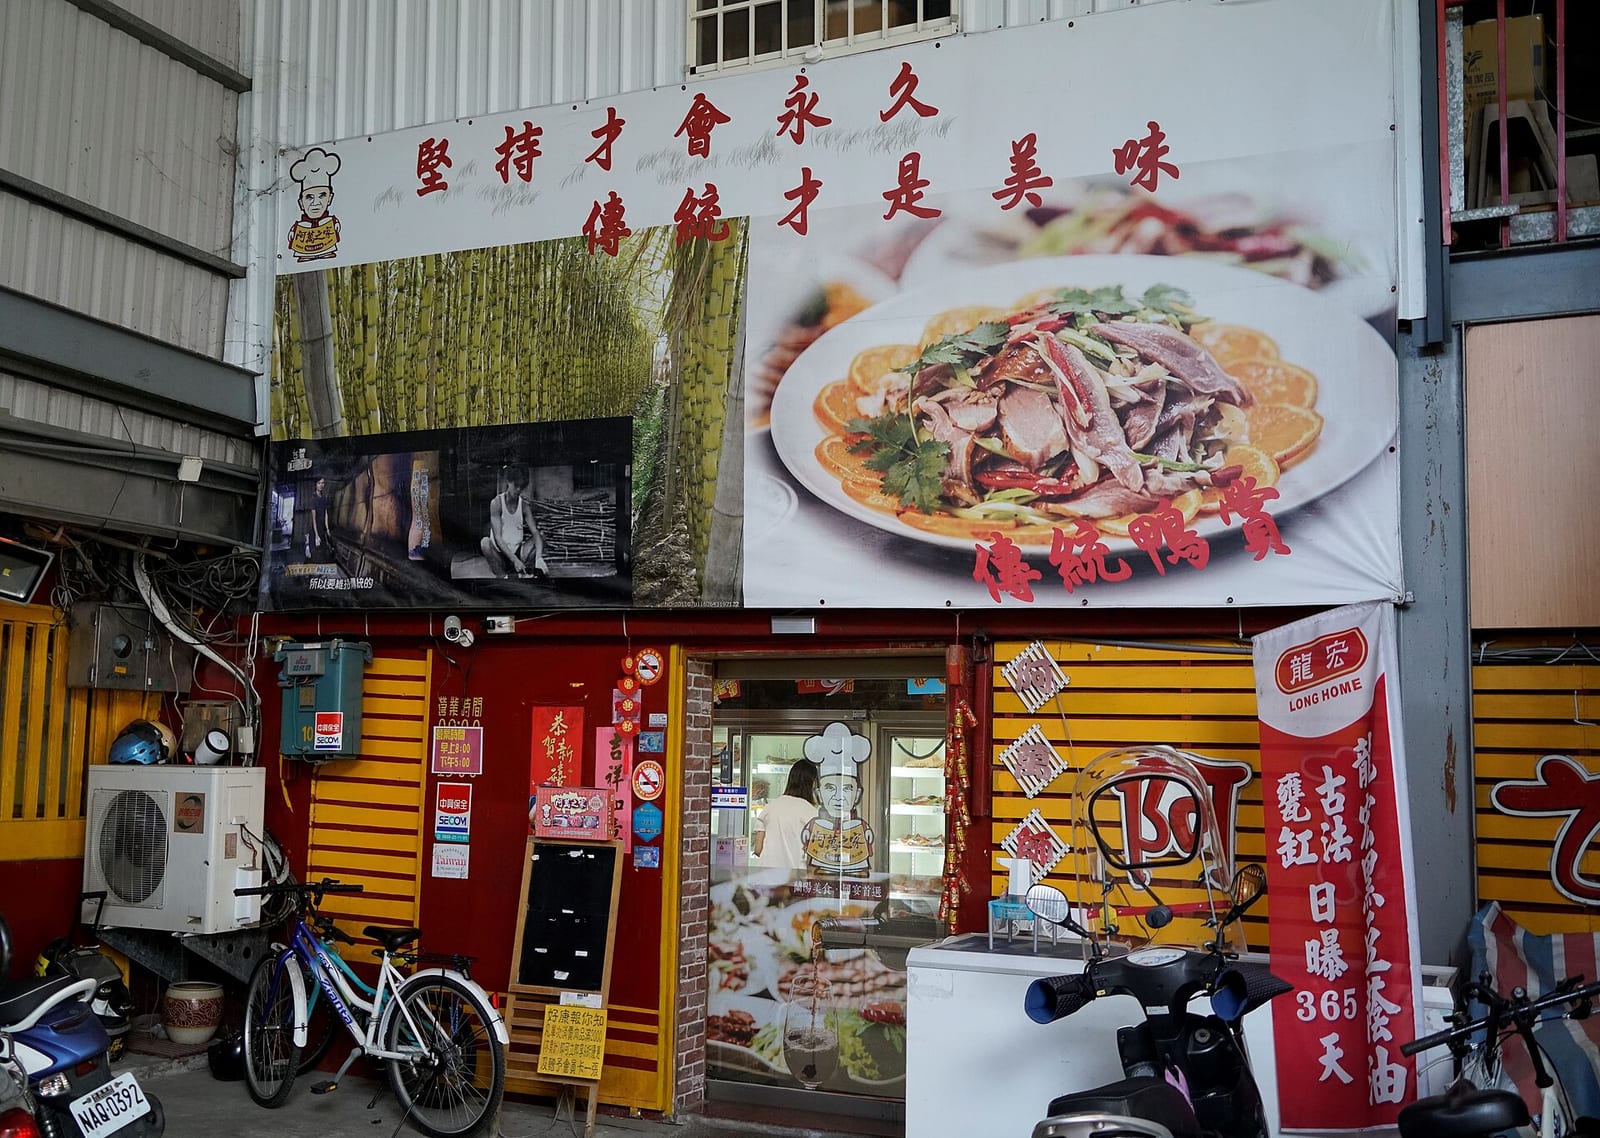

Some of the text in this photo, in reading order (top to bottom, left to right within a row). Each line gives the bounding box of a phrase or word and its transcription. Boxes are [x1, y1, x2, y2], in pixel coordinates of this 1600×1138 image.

[416, 61, 939, 197] 堅持才會永久
[582, 120, 1180, 256] 傳統才是美味
[972, 476, 1292, 603] 傳統鴨賞
[1290, 640, 1349, 686] 龍宏
[438, 696, 483, 717] 營業時間
[1289, 677, 1363, 712] LONG HOME
[302, 726, 314, 741] 10
[316, 736, 340, 744] SECOM
[439, 815, 467, 826] SECOM
[1315, 765, 1353, 864] 古法
[436, 854, 467, 867] Taiwan
[78, 1083, 144, 1133] NAQ-0392
